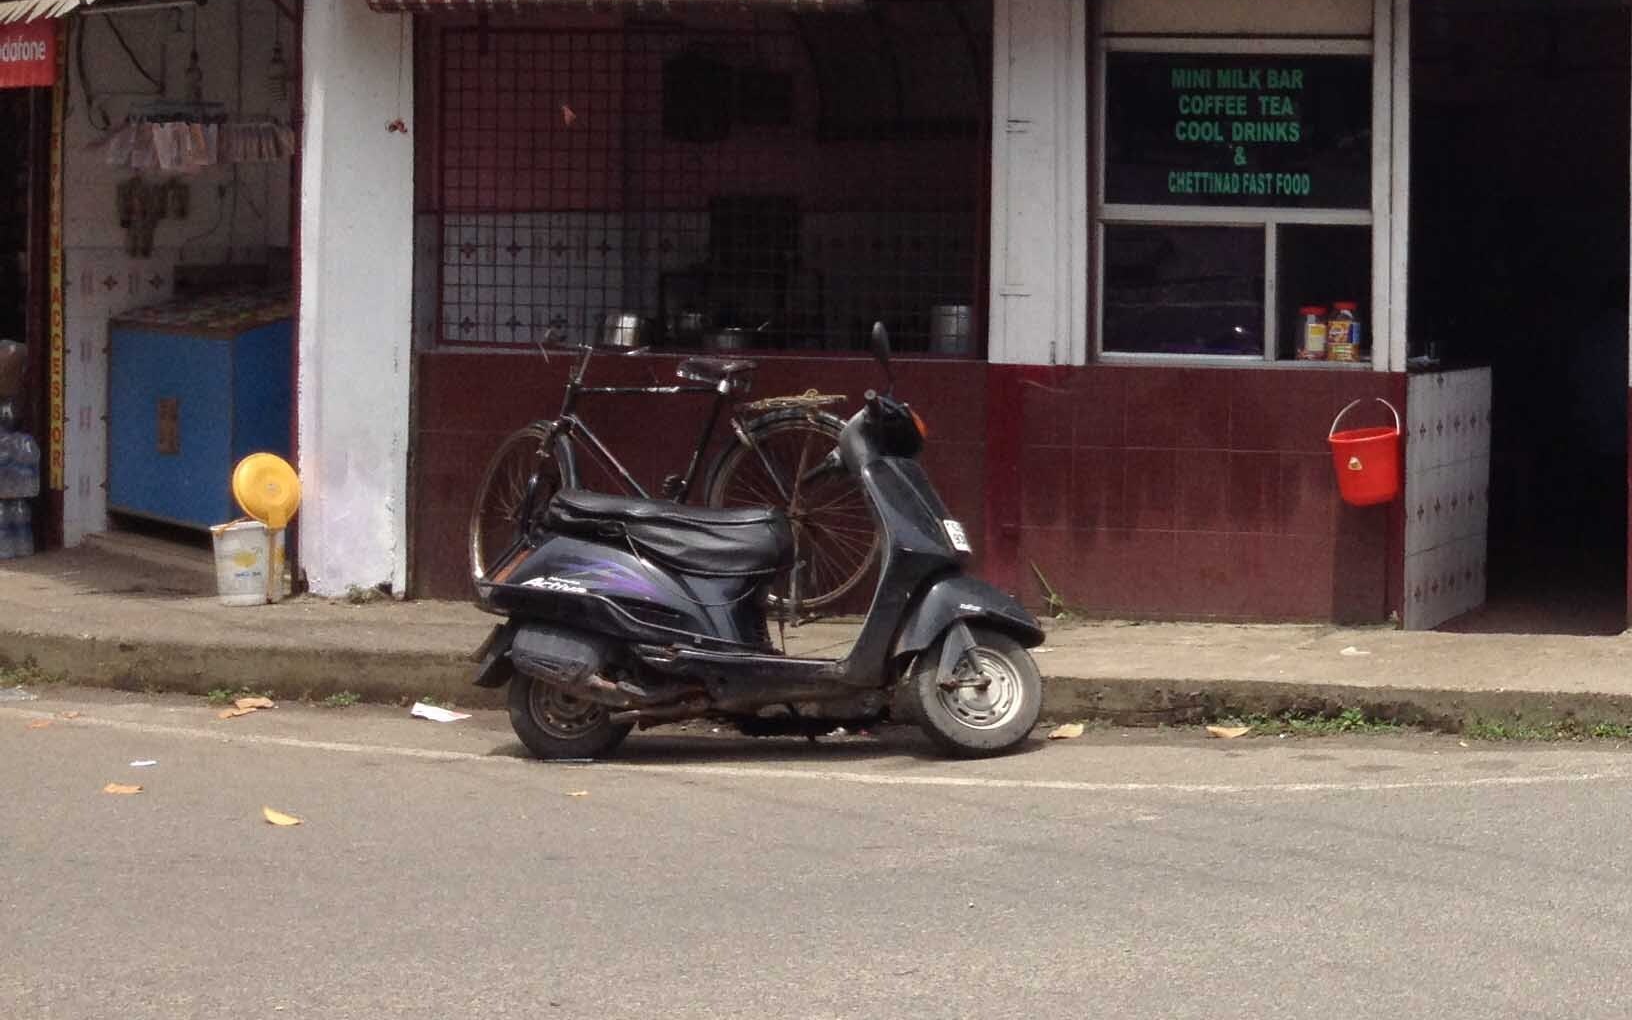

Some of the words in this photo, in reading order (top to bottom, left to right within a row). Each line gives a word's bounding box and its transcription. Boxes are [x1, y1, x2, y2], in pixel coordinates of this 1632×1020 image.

[0, 36, 46, 62] dafone
[1172, 69, 1211, 89] MINI
[1217, 69, 1262, 89] MILK
[1267, 69, 1304, 89] BAR
[1179, 95, 1248, 116] COFFEE
[1258, 95, 1294, 116] TEA
[1175, 122, 1224, 142] COOL
[1231, 122, 1301, 142] DRINKS
[1234, 146, 1247, 166] &
[1168, 171, 1240, 194] CHETTINAD
[1242, 173, 1273, 195] FAST
[1276, 173, 1310, 196] FOOD
